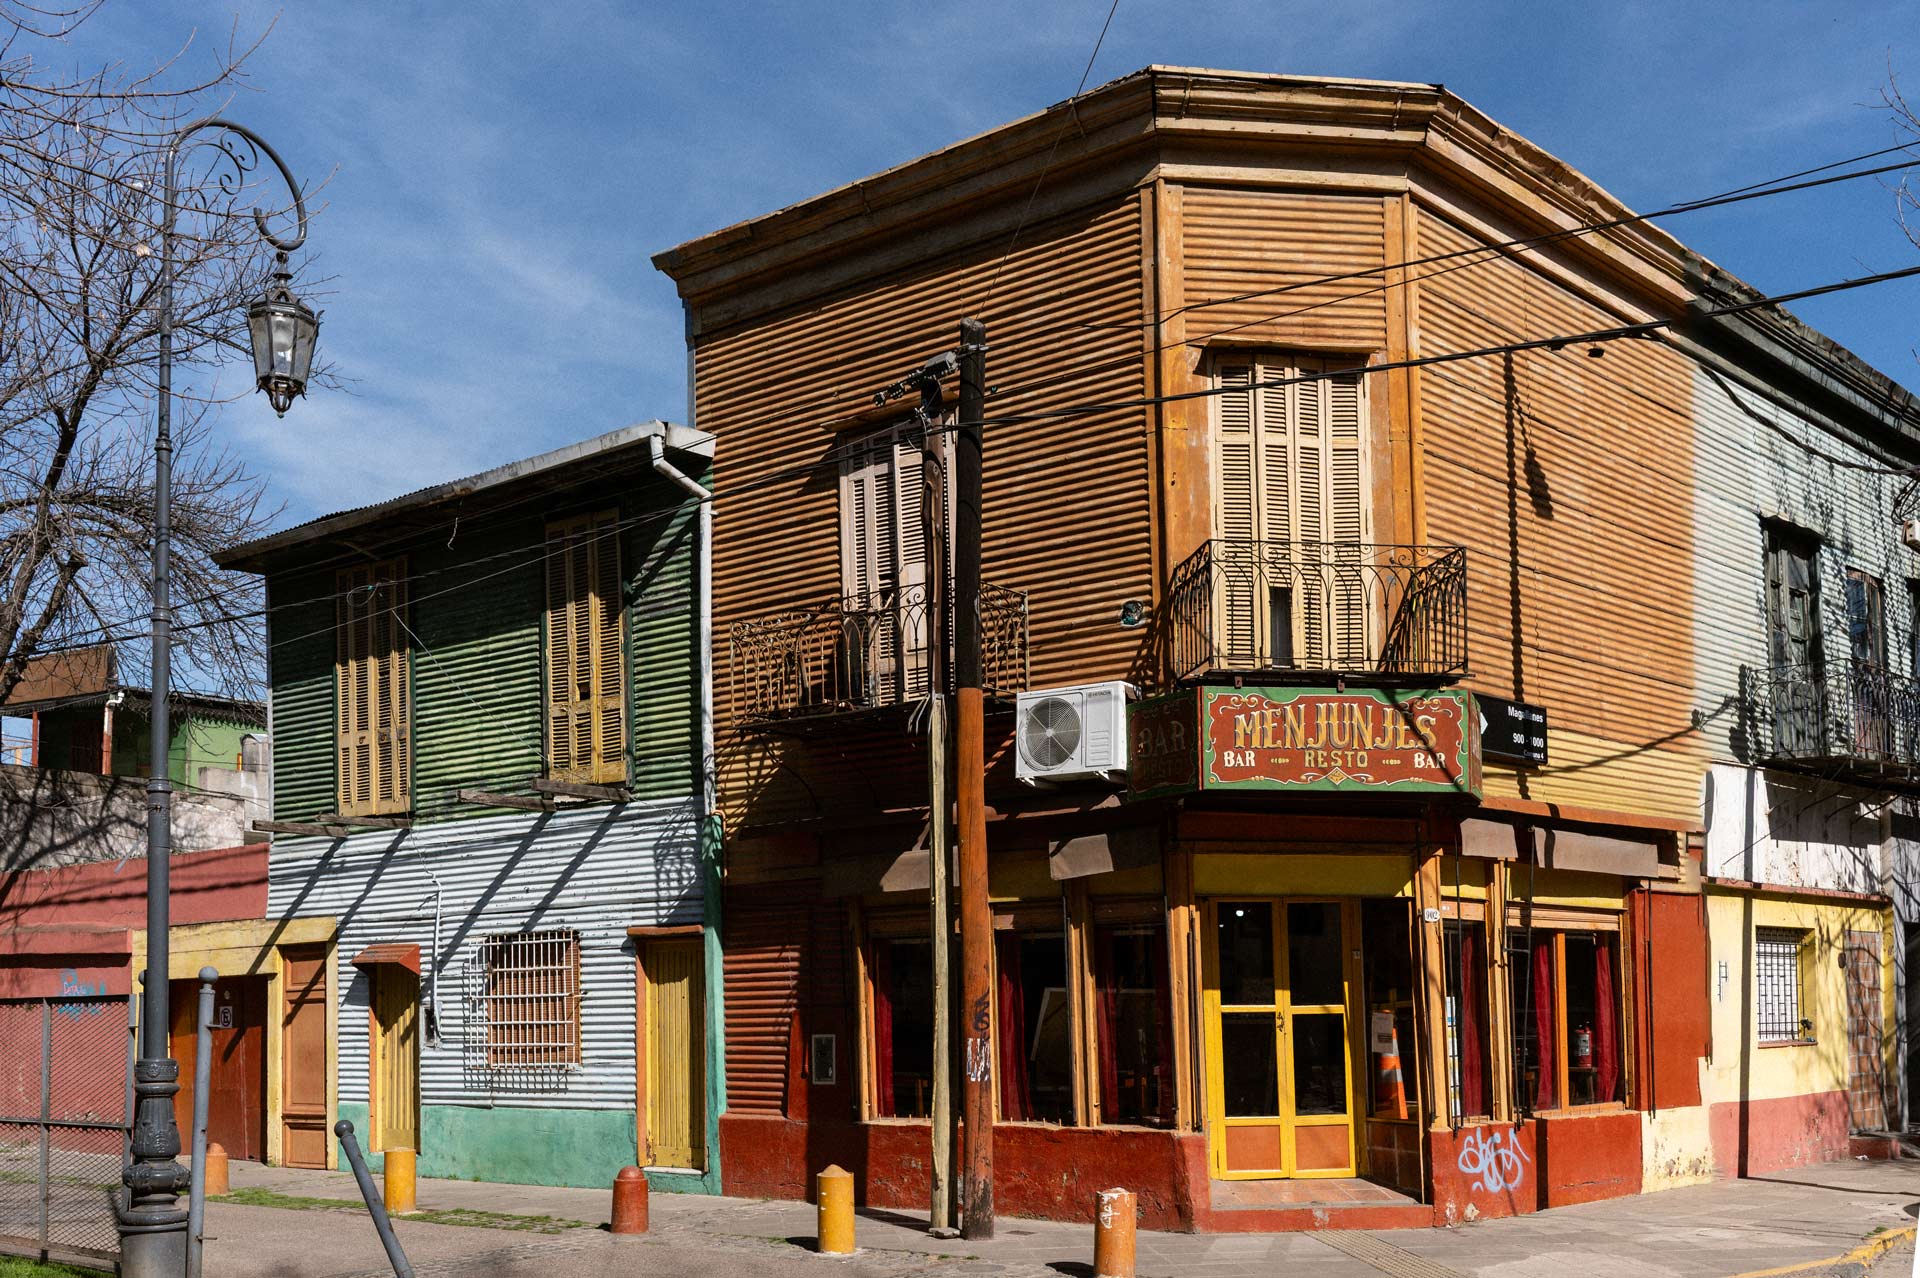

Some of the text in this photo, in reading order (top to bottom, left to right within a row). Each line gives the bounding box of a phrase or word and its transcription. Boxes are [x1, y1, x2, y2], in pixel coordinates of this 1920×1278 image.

[1234, 702, 1437, 750] MENJUNJES
[1136, 720, 1186, 757] BAR
[1512, 732, 1525, 745] 900
[1530, 736, 1545, 749] 1000
[1223, 750, 1447, 769] BAR RESTO BAR
[1425, 910, 1439, 920] 902
